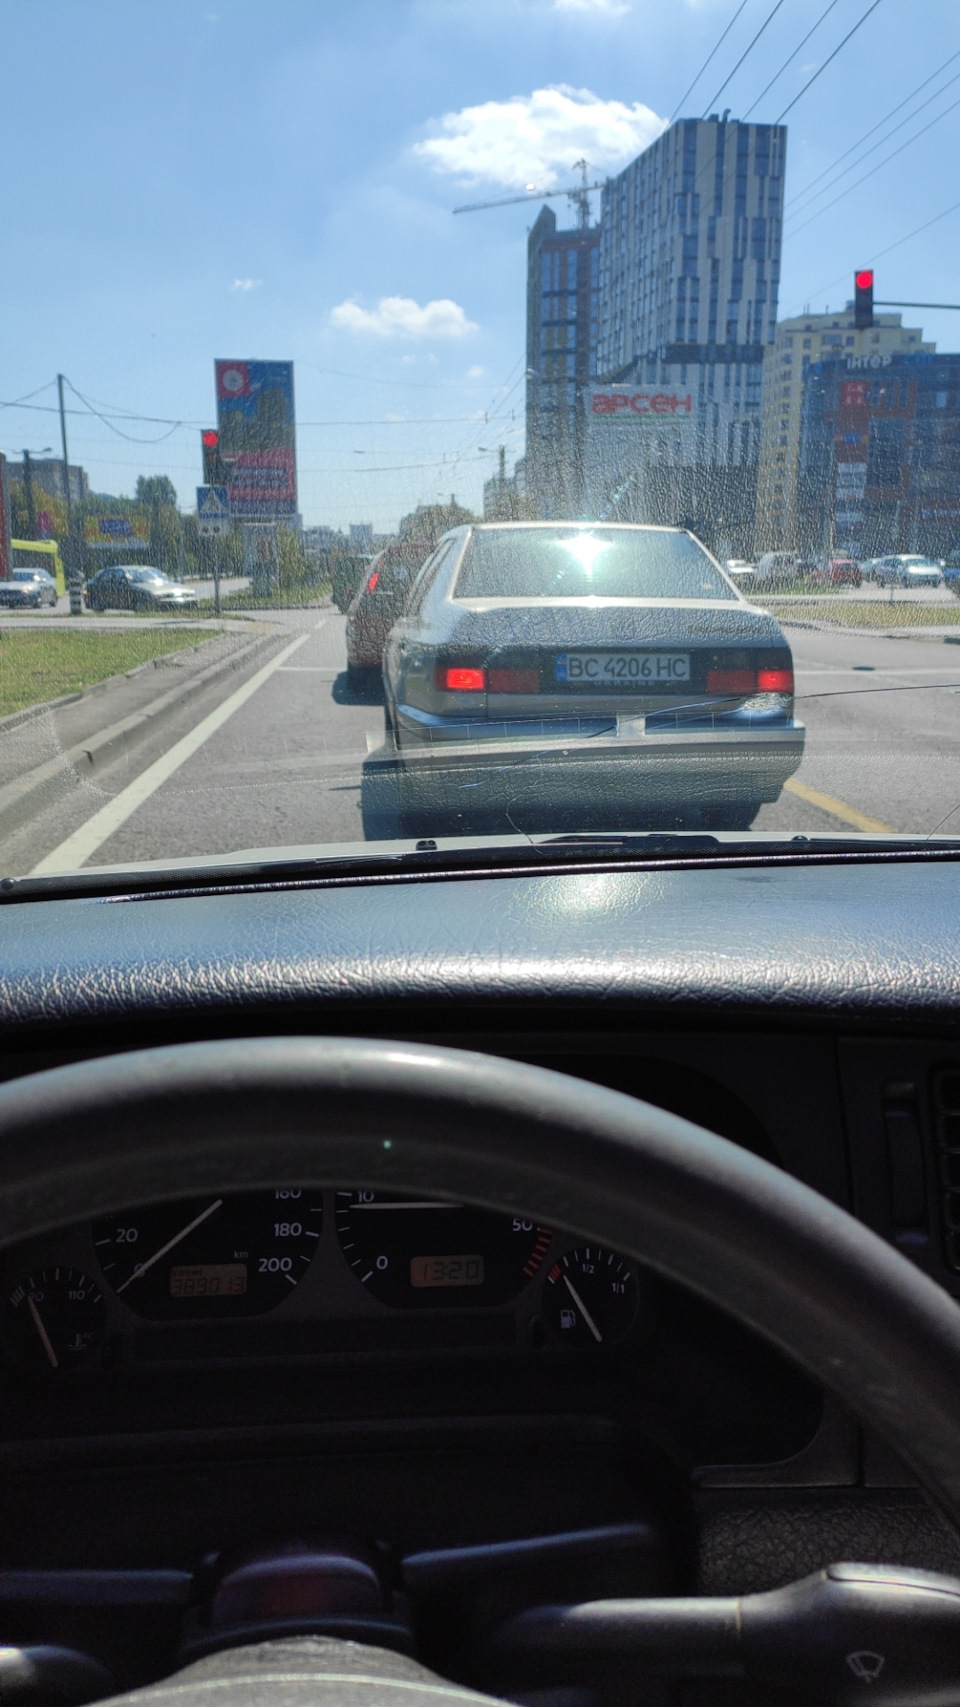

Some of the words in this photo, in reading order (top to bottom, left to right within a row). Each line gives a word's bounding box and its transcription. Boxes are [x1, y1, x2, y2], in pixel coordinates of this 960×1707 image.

[569, 658, 598, 677] BC
[604, 658, 651, 677] 4206
[657, 658, 686, 677] HC
[115, 1228, 139, 1243] 20
[274, 1222, 302, 1236] 180
[233, 1250, 248, 1259] km
[258, 1257, 293, 1272] 200
[376, 1255, 389, 1270] 0
[582, 1264, 595, 1274] 1/2
[68, 1289, 86, 1300] 110
[611, 1282, 625, 1294] 1/1
